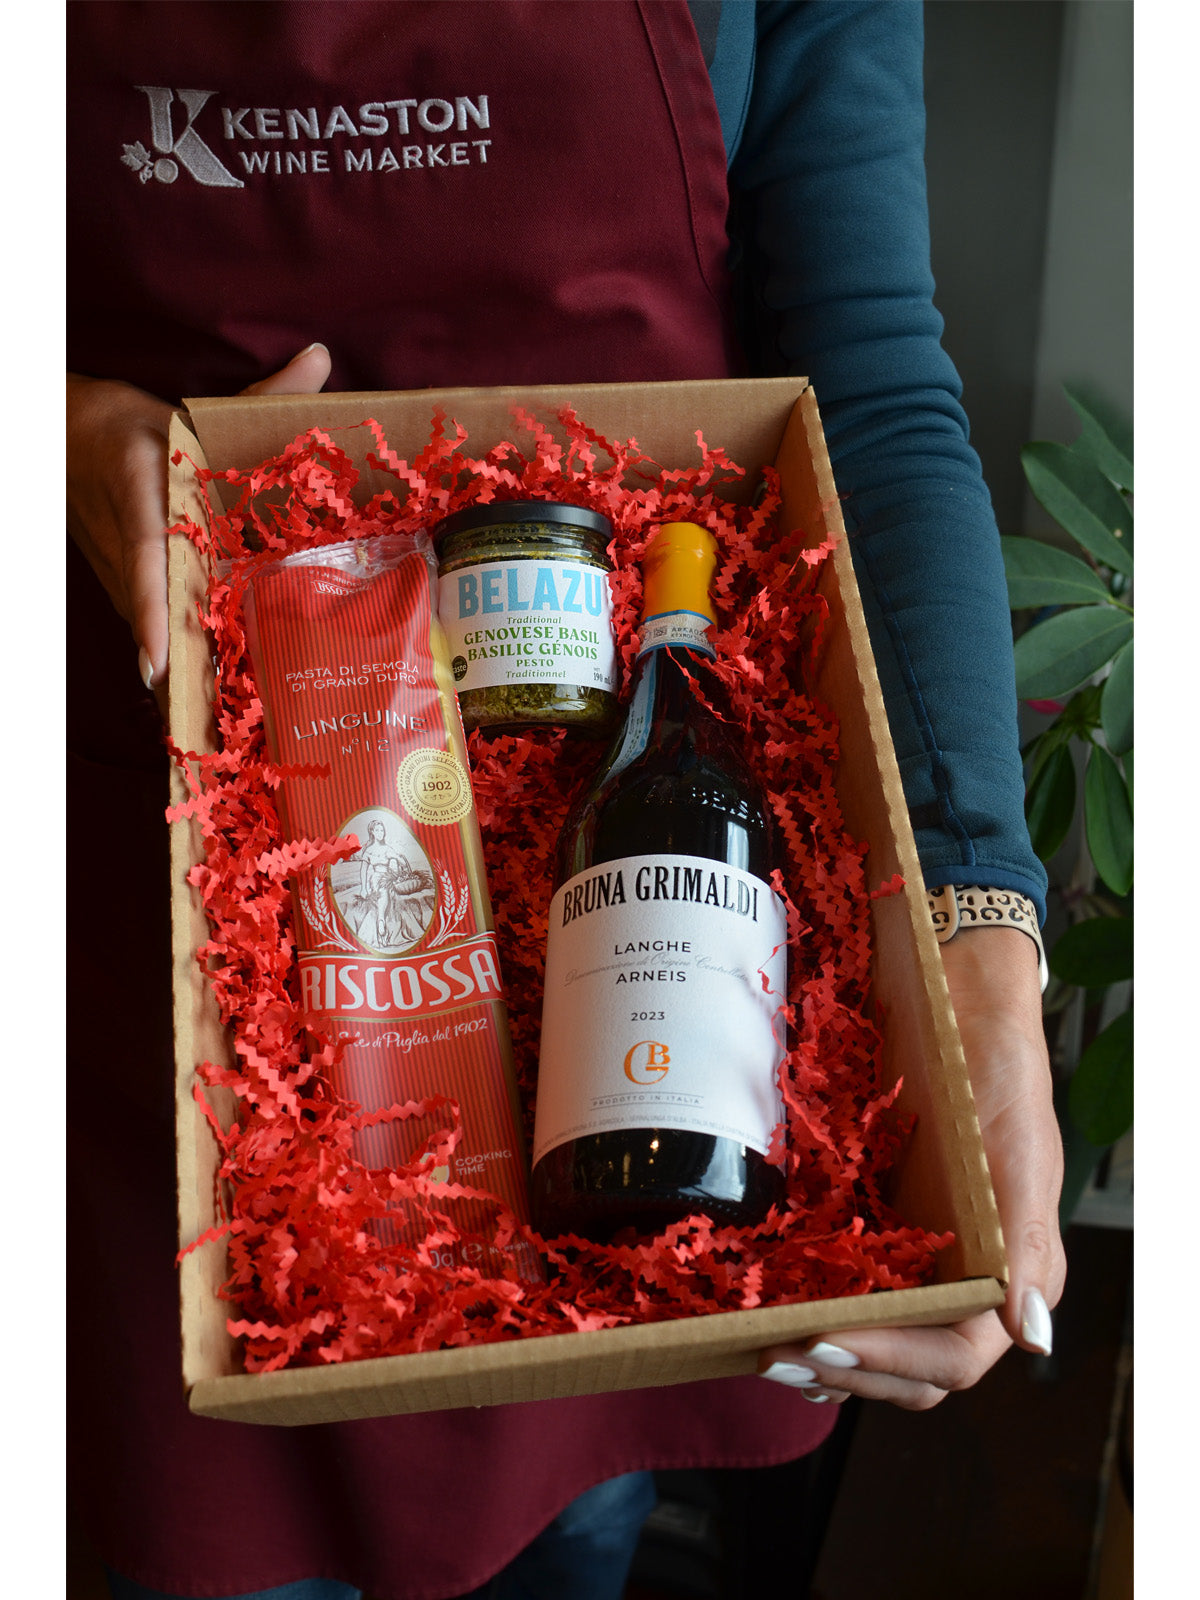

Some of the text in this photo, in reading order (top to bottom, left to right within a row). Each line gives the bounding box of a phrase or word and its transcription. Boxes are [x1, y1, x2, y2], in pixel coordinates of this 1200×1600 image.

[221, 95, 491, 140] KENASTON
[239, 140, 492, 175] WINE MARKET
[458, 567, 602, 620] BELAZU
[507, 616, 562, 625] Traditional
[464, 626, 600, 645] GENOVESE BASIL
[468, 643, 535, 661] BASILIC
[538, 639, 599, 660] GÉNOIS
[286, 660, 419, 683] PASTA DI SEMOLA
[452, 661, 468, 675] aste
[516, 659, 555, 668] PESTO
[292, 672, 417, 693] DI GRANO DURO
[506, 670, 567, 679] Traditionnel
[593, 671, 604, 682] 190
[294, 709, 429, 741] LINGUINE
[422, 781, 452, 792] 1902
[405, 789, 438, 816] GARANZIA
[562, 866, 758, 928] BRUNA GRIMALDI
[615, 940, 692, 955] LANGHE
[301, 949, 502, 1014] RISCOSSA
[616, 971, 687, 985] ARNEIS
[631, 1011, 665, 1022] 2023
[372, 1036, 382, 1048] di
[383, 1030, 430, 1054] Puglia
[433, 1026, 451, 1041] dal
[453, 1018, 488, 1036] 1902
[593, 1095, 645, 1107] PRODOTTO
[666, 1096, 700, 1105] ITALIA
[455, 1150, 512, 1167] COOKING
[457, 1163, 486, 1177] TIME
